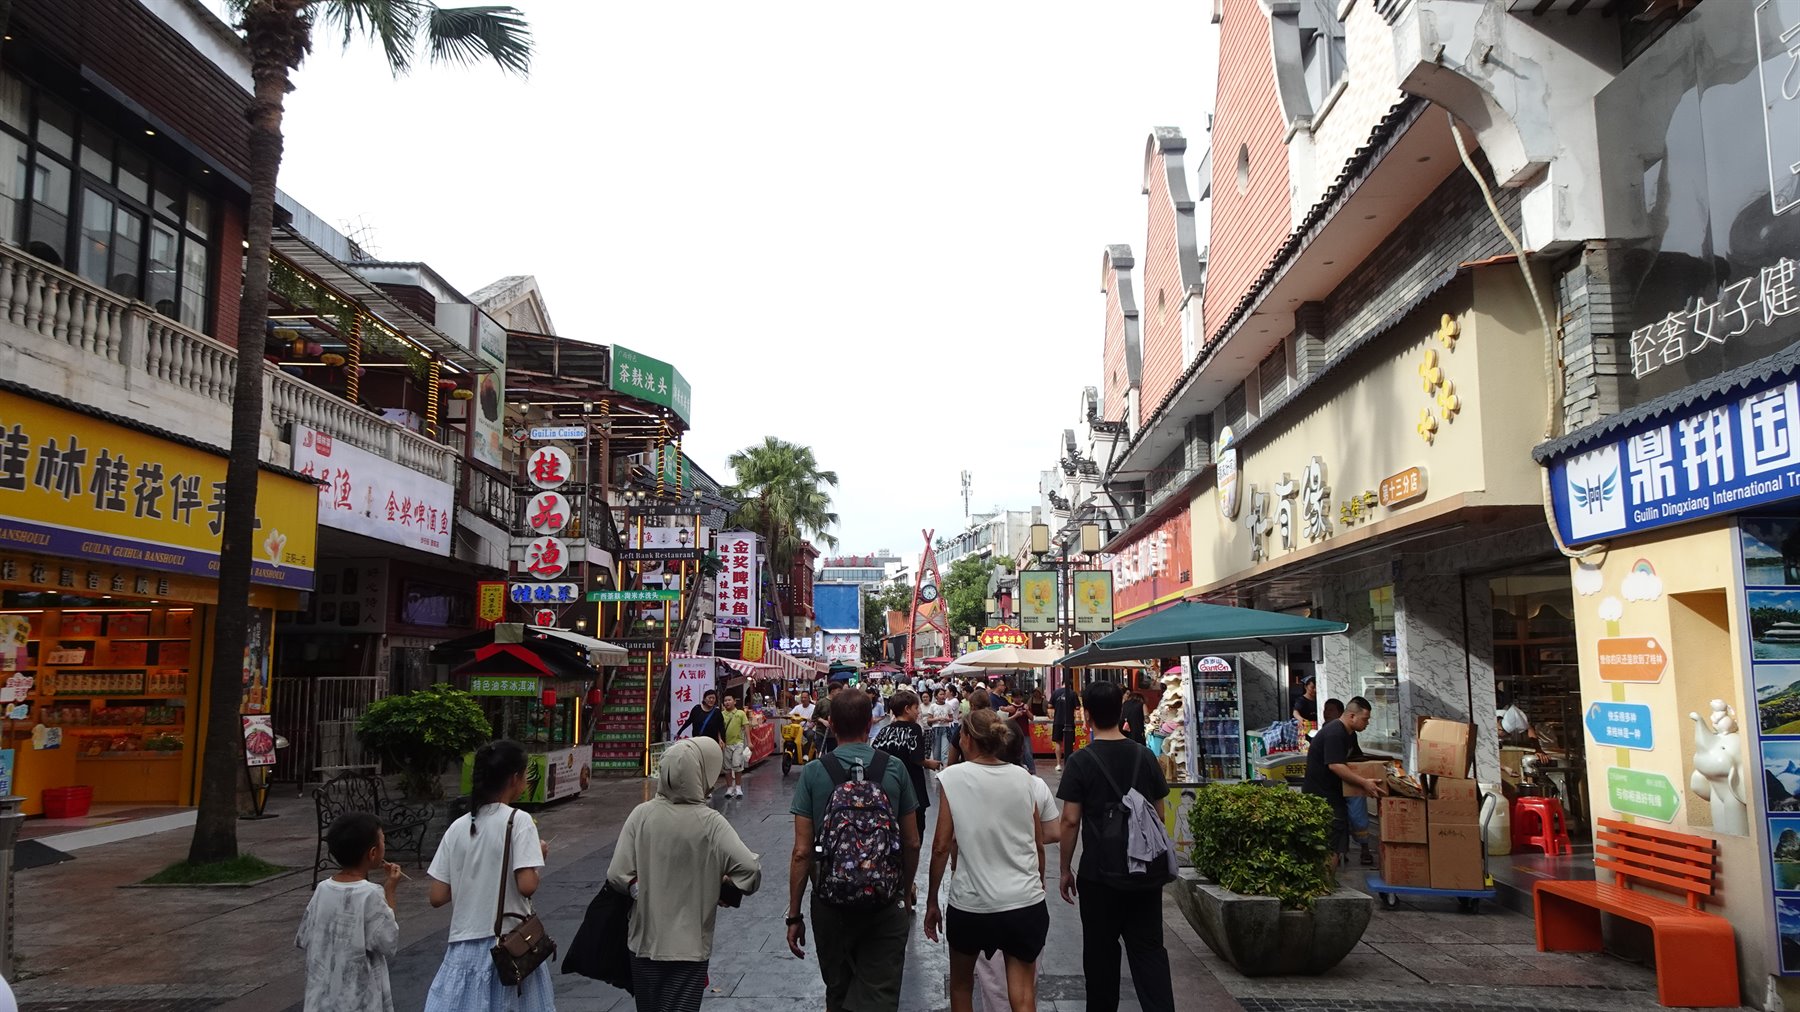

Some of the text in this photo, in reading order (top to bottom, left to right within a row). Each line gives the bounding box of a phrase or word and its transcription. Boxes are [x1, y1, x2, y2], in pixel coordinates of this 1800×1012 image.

[1630, 257, 1800, 379] 轻奢女子健
[619, 363, 668, 395] 茶麸洗头
[532, 428, 584, 438] GuiLin Cuisine
[1627, 380, 1800, 505] 鼎翔国
[0, 424, 262, 536] 桂林桂花伴手
[1382, 472, 1419, 501] 第十三分店
[1633, 504, 1659, 523] Guilin
[1662, 496, 1710, 517] Dingxiang
[1713, 475, 1783, 506] International
[385, 491, 449, 535] 金奖啤酒鱼
[82, 541, 185, 566] GUILIN GUIHUA BANSHOULI
[655, 551, 695, 559] Restaurant
[732, 540, 749, 615] 金奖啤酒鱼
